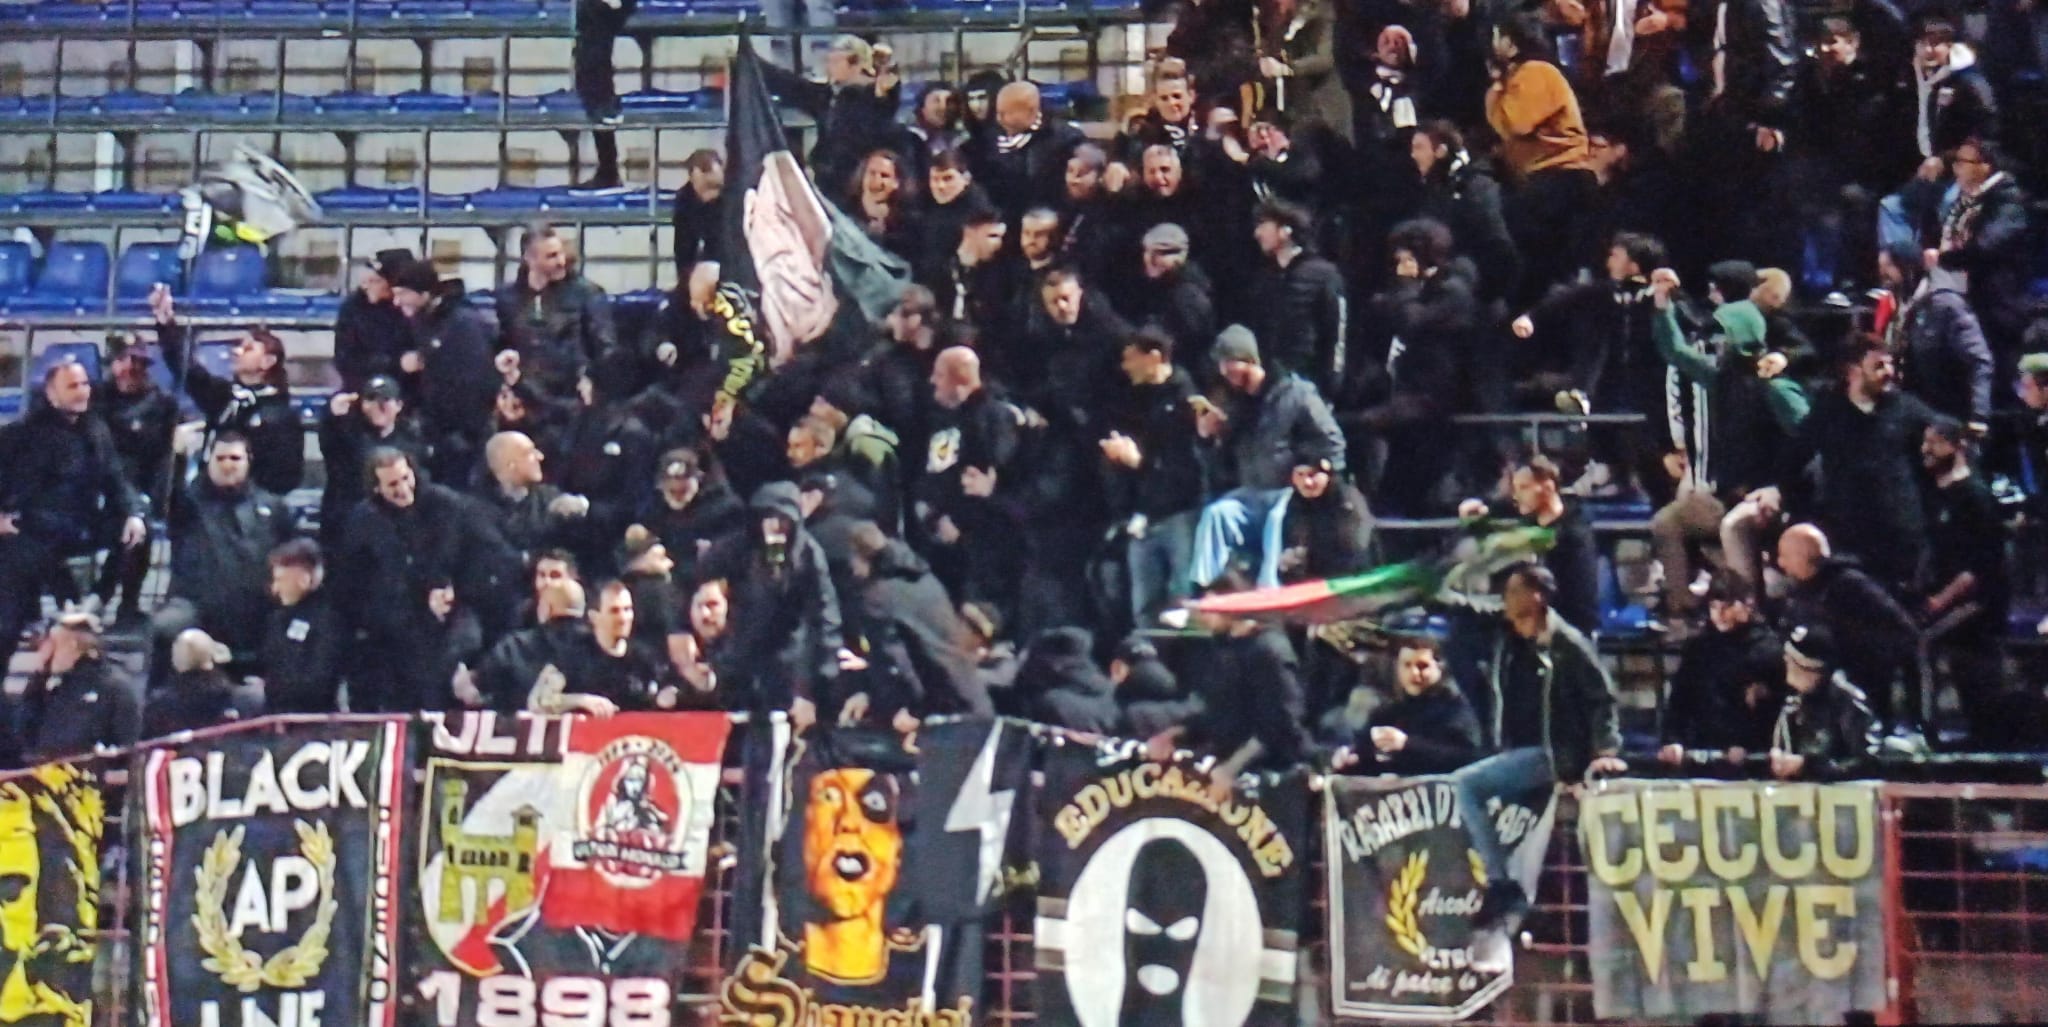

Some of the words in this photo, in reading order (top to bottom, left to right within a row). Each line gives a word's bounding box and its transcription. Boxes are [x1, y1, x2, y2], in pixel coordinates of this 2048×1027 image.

[168, 740, 370, 827] BLACK
[1583, 785, 1874, 886] CECCO
[228, 856, 319, 937] AP
[1614, 885, 1857, 984] VIVE
[418, 970, 671, 1027] 1898
